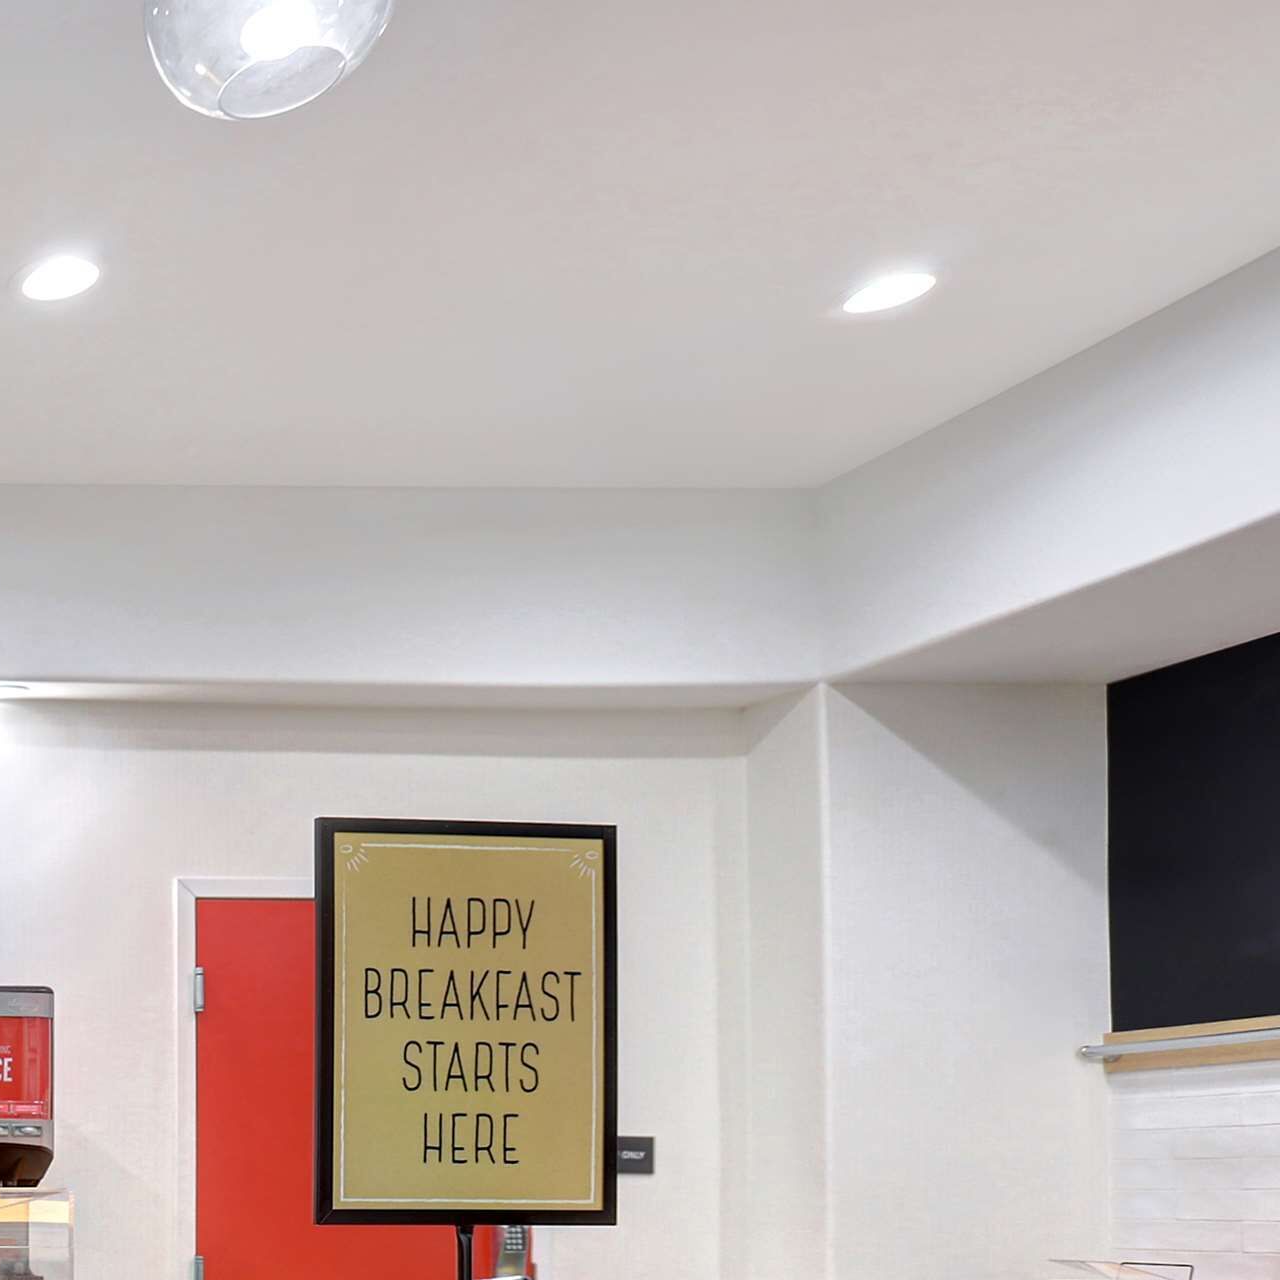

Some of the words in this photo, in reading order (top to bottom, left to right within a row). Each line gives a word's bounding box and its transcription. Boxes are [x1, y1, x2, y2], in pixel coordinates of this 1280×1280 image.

[410, 895, 536, 951] HAPPY
[362, 966, 583, 1023] BREAKFAST
[401, 1040, 541, 1094] STARTS
[422, 1111, 521, 1166] HERE
